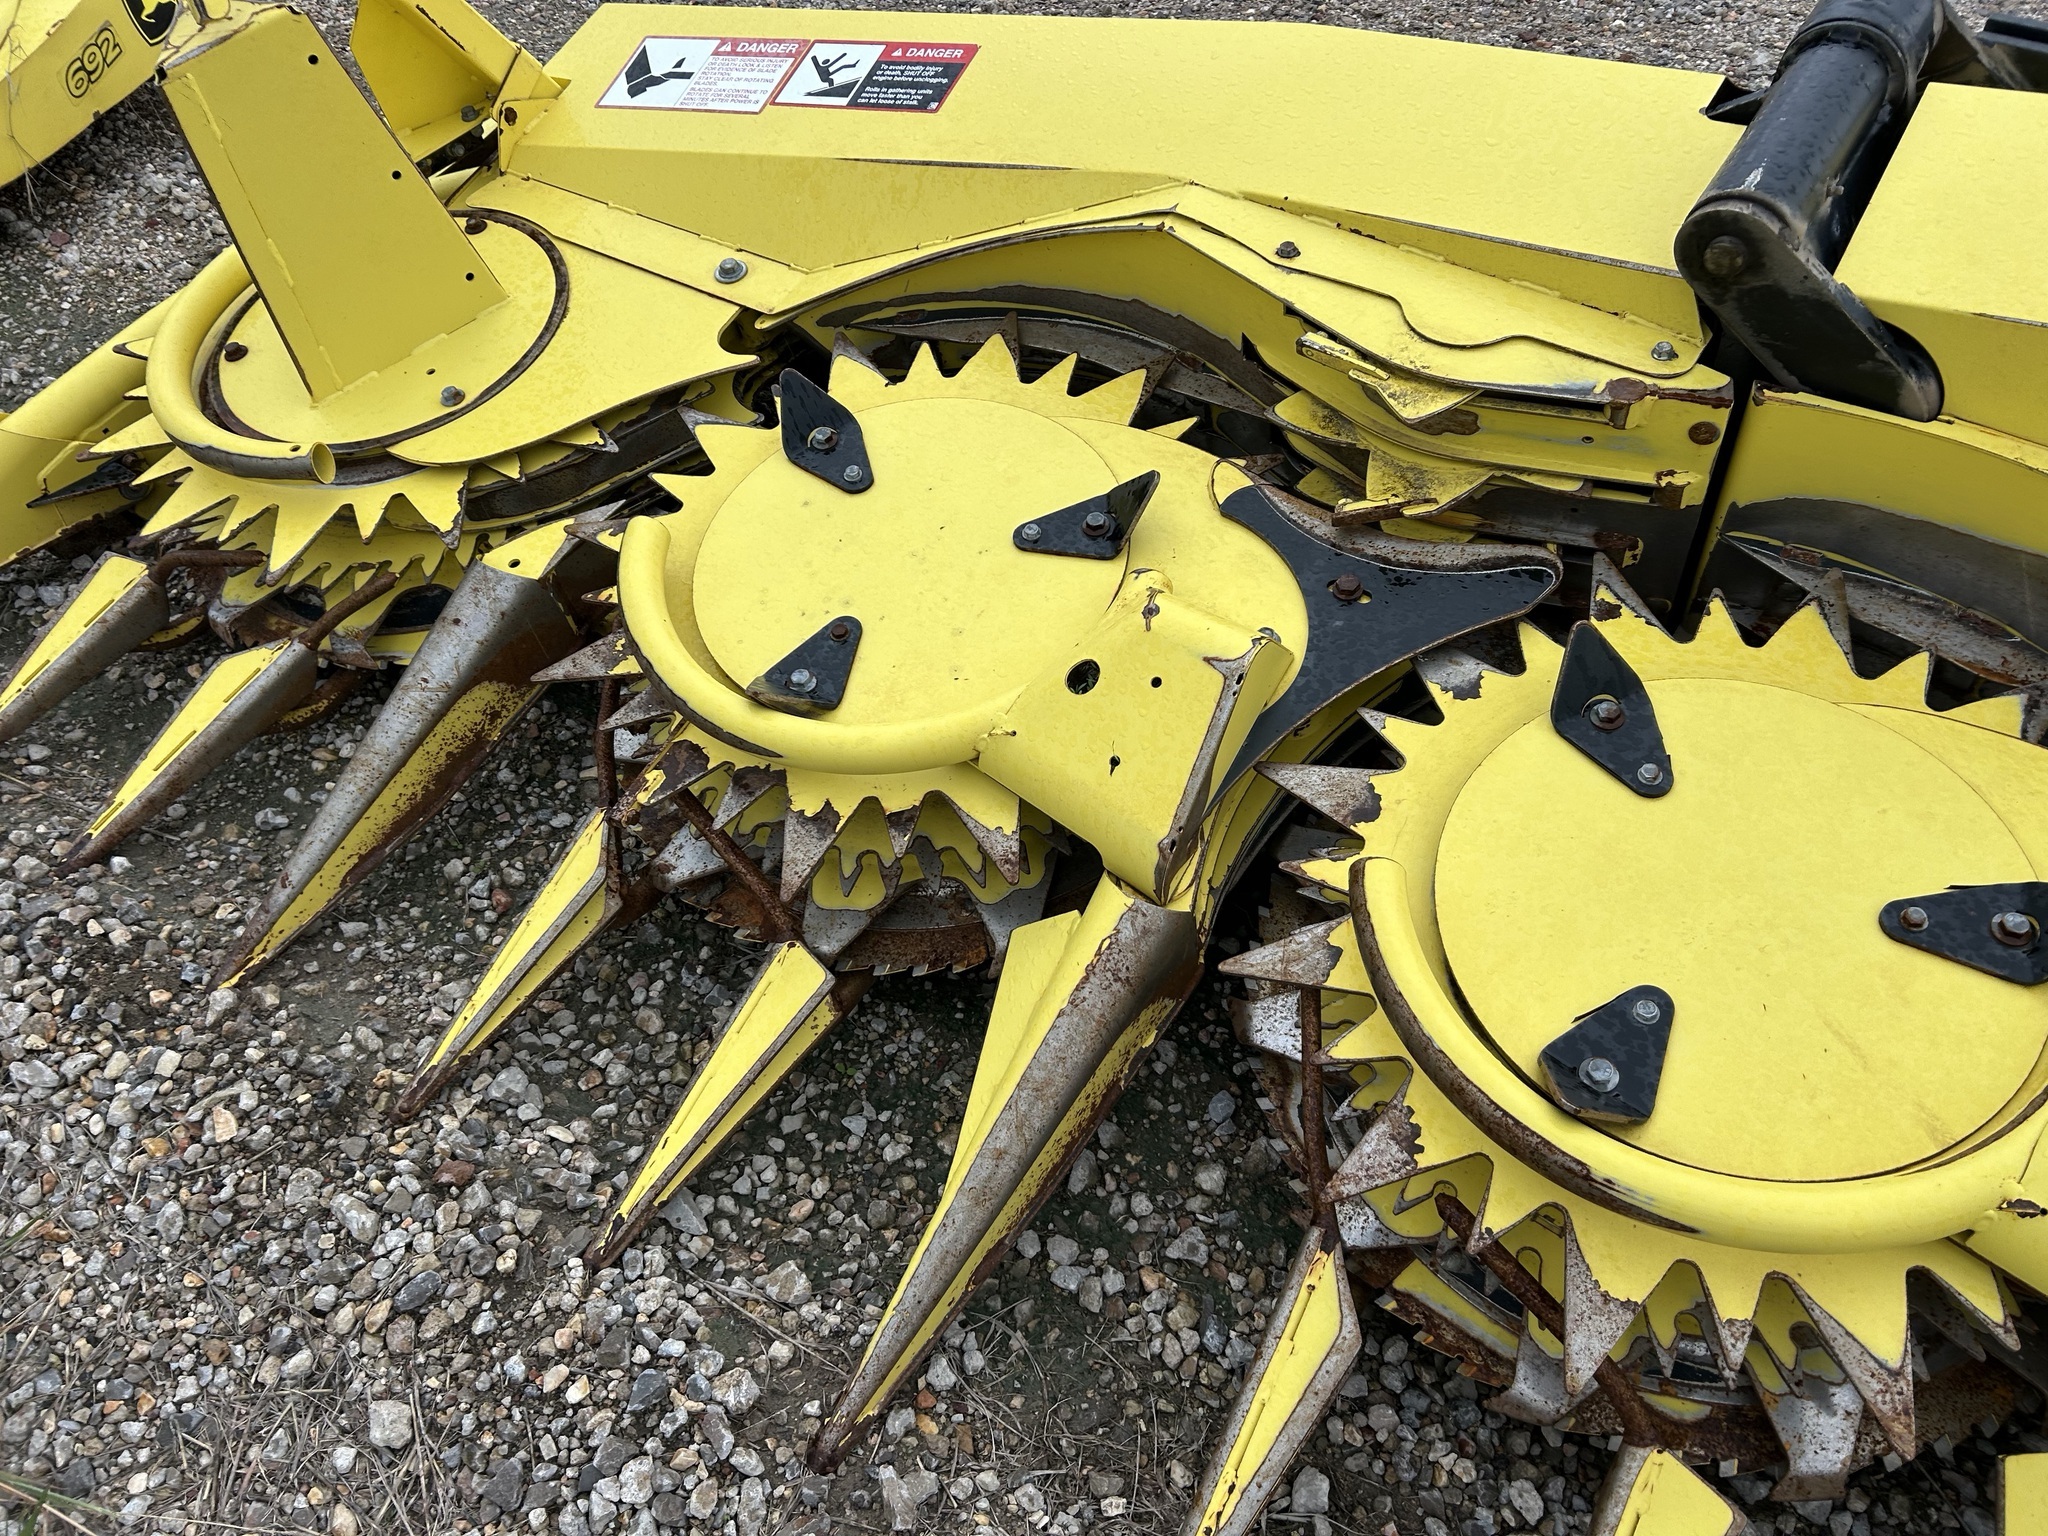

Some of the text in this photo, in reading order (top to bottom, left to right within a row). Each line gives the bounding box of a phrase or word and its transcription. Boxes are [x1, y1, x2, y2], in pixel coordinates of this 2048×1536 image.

[736, 42, 799, 53] DANGER
[906, 48, 964, 58] DANGER
[65, 27, 123, 98] 692
